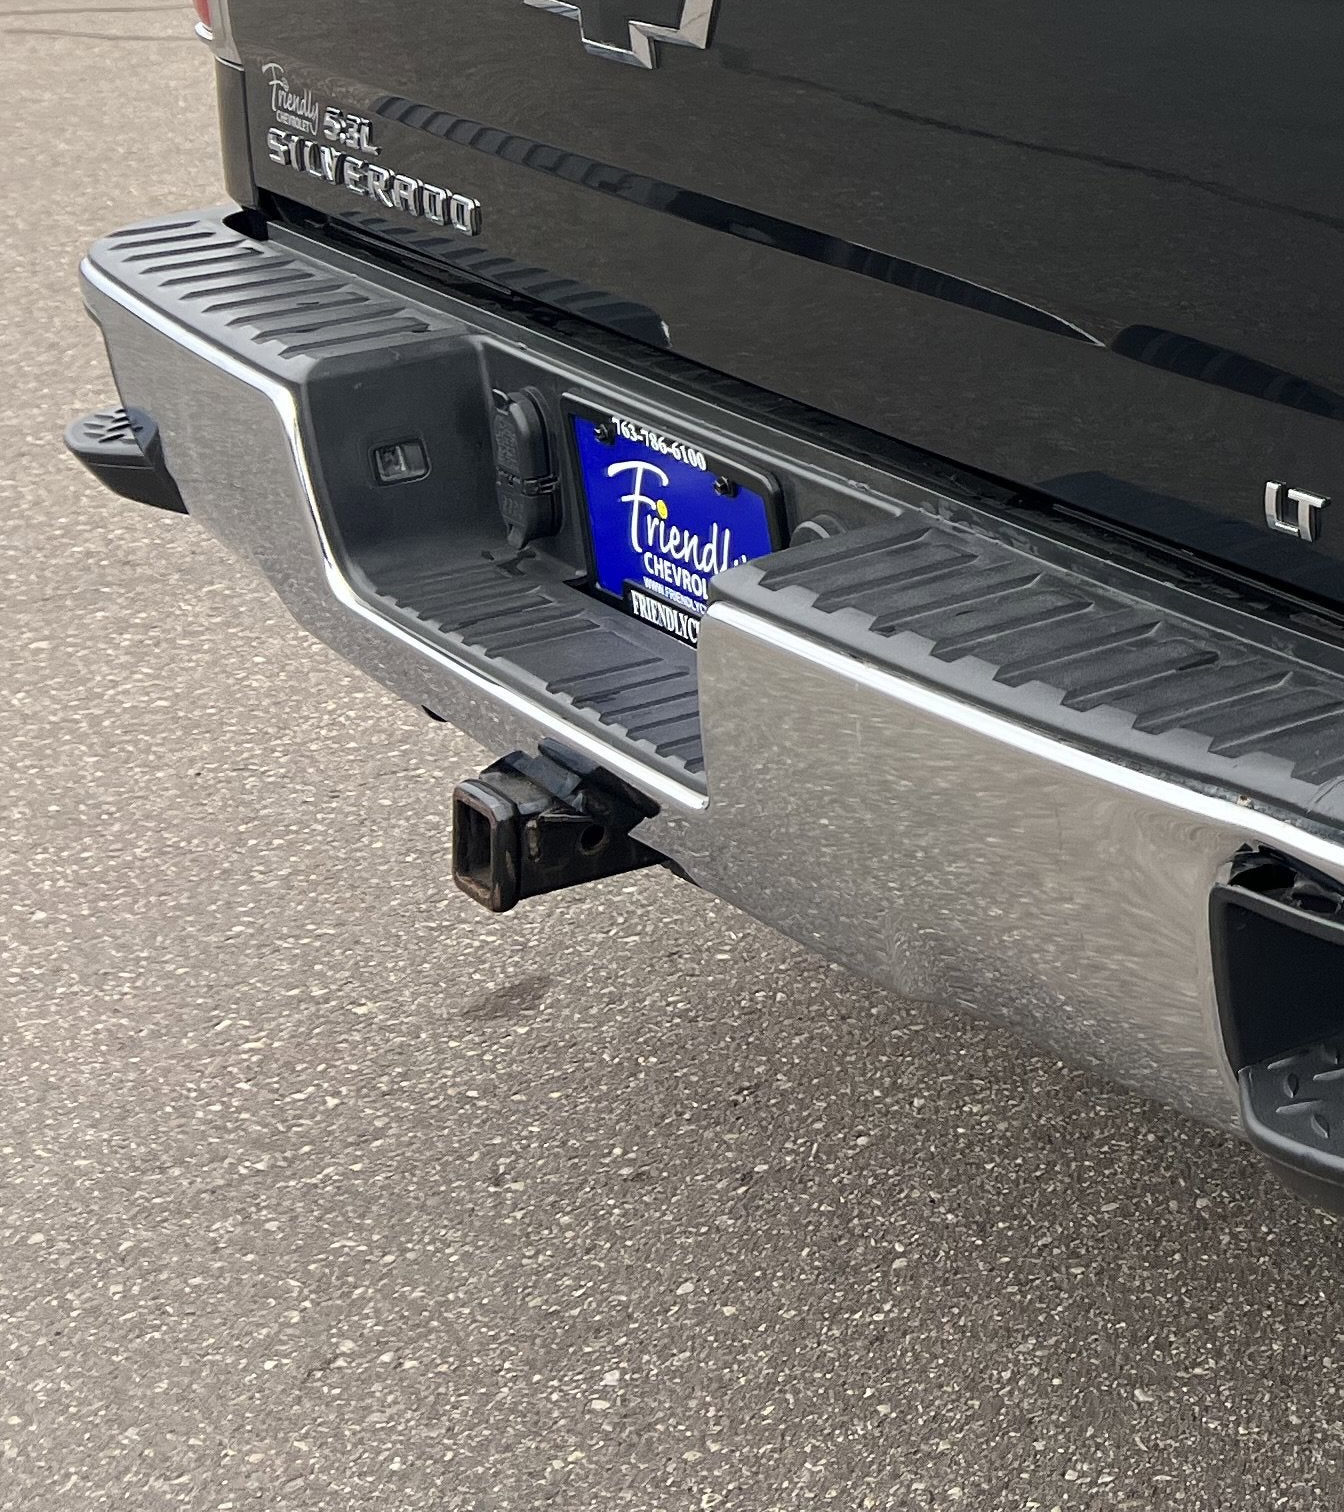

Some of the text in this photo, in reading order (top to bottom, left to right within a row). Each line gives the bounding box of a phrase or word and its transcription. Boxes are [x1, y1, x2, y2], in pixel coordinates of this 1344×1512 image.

[262, 62, 319, 136] Friendly
[322, 106, 382, 156] 5.3L
[266, 126, 483, 236] SILVERADO
[611, 417, 708, 472] 763-786-6100
[1263, 479, 1332, 543] LT
[643, 551, 710, 601] CHEVROL
